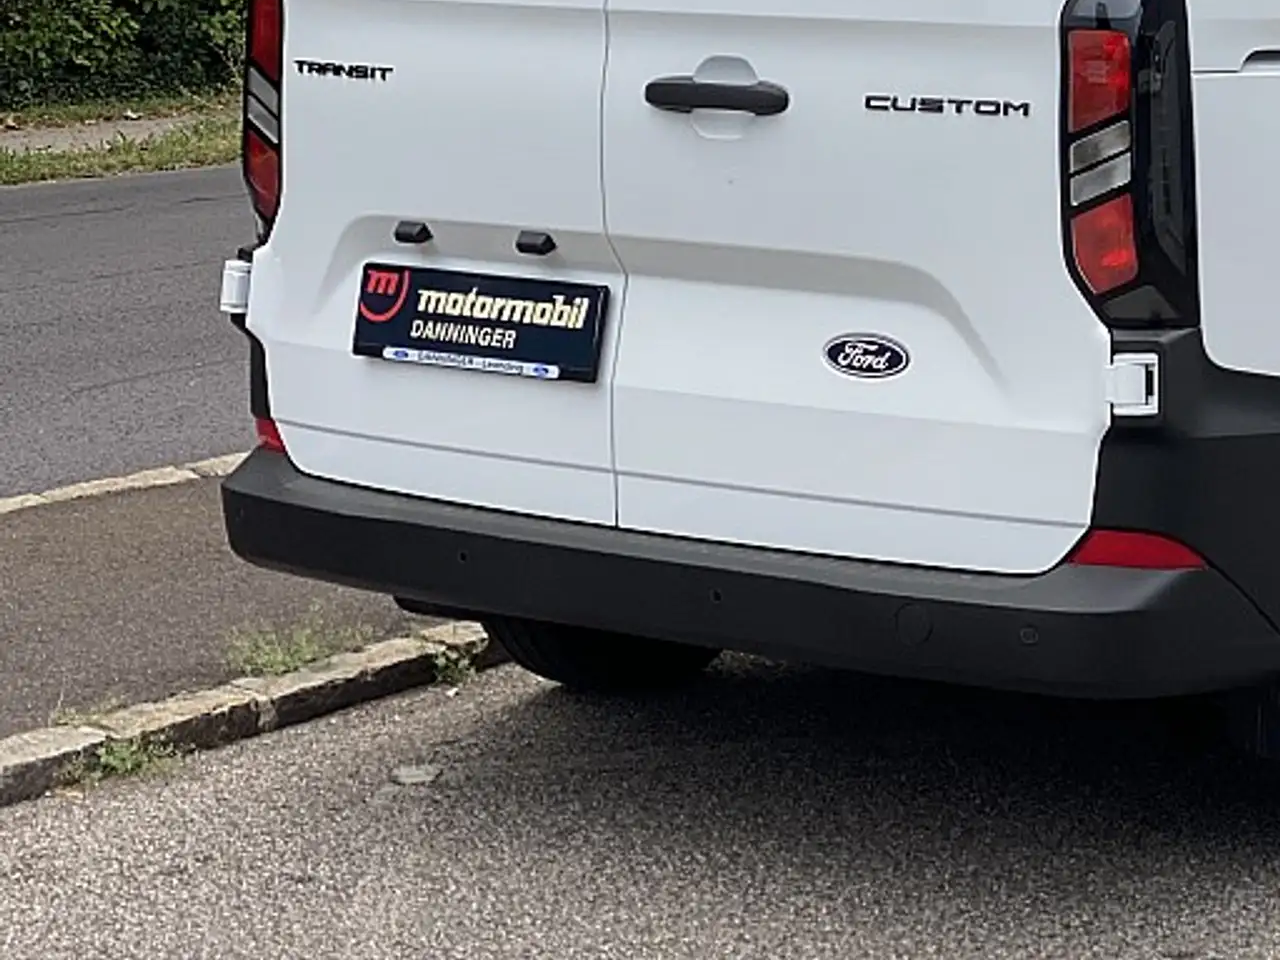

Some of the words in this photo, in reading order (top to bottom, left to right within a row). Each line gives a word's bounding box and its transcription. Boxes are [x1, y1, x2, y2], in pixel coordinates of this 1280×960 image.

[293, 60, 394, 81] TRANSIT
[864, 95, 1031, 117] CUSTOM
[417, 286, 590, 329] motormobil
[409, 319, 517, 349] DANNINGER
[837, 342, 891, 370] Ford
